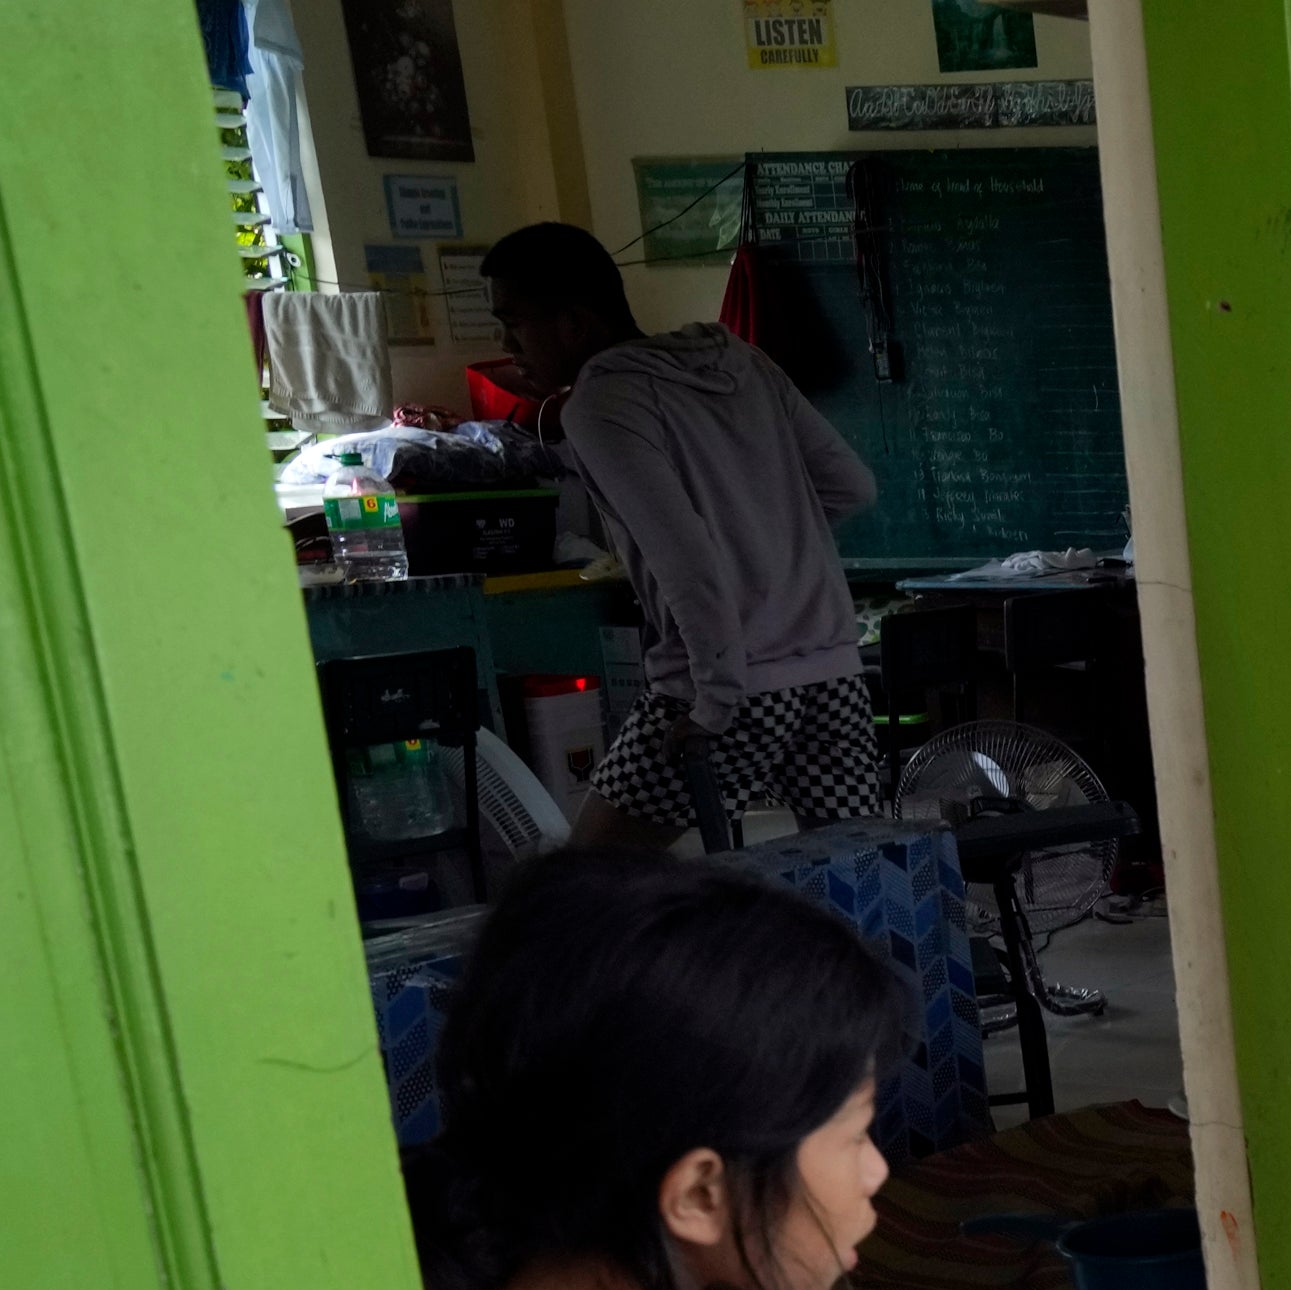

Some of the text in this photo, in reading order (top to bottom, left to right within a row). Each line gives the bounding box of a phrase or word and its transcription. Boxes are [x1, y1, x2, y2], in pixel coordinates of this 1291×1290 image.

[754, 18, 823, 46] LISTEN
[760, 48, 819, 64] CAREFULLY
[756, 160, 856, 176] ATTENDANCE CHA
[765, 211, 796, 224] DAILY
[759, 228, 782, 240] DATE
